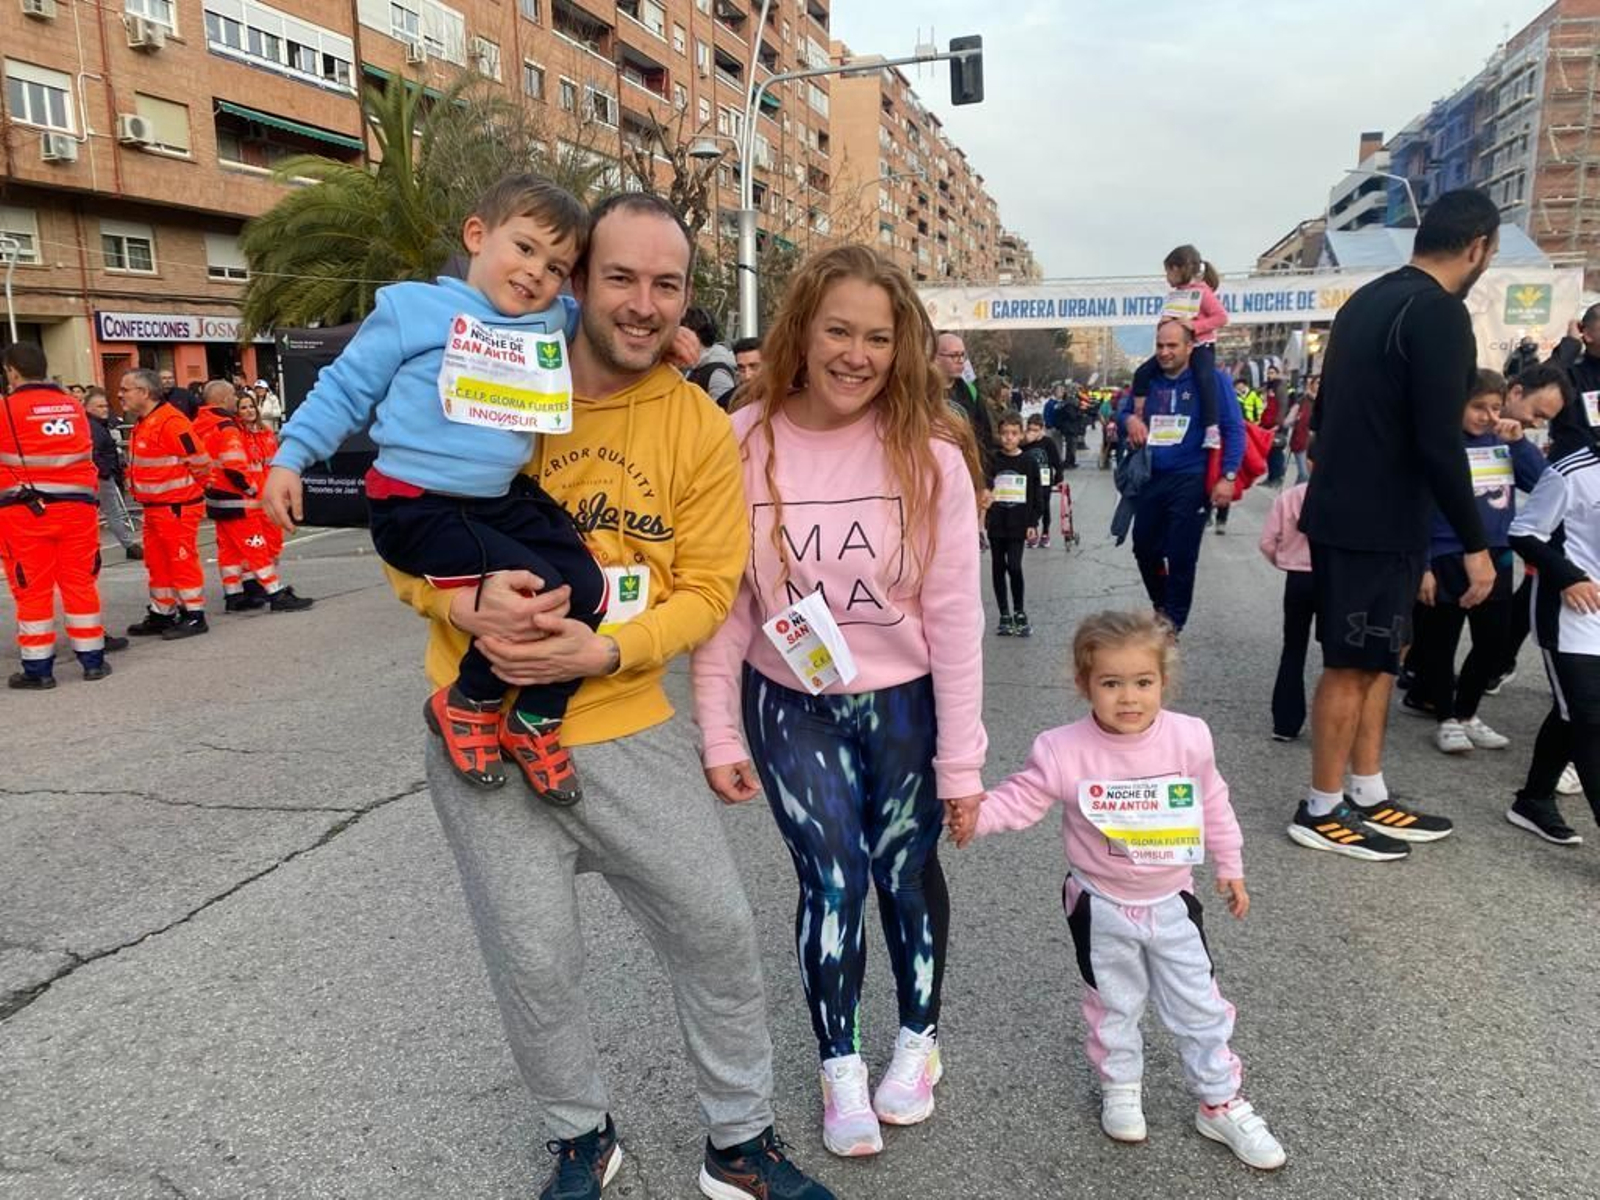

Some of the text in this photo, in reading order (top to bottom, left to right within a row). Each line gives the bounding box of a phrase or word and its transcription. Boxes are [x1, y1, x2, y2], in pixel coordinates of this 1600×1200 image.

[973, 300, 988, 320] 41
[992, 299, 1053, 319] CARRERA
[1058, 298, 1117, 318] URBANA
[1243, 290, 1291, 312] NOCHE
[1295, 290, 1316, 310] DE
[103, 316, 243, 339] CONFECCIONES JOSM
[452, 338, 482, 354] SAN
[484, 347, 525, 365] ANTÓN
[471, 329, 524, 353] NOCHE DE
[489, 394, 525, 409] GLORIA
[529, 400, 569, 412] FUERTES
[41, 418, 75, 436] 061
[469, 406, 538, 428] INNOVASUR
[597, 447, 655, 498] QUALITY
[787, 624, 809, 645] SAN
[1092, 800, 1116, 811] SAN
[1106, 790, 1158, 800] NOCHE DE
[1130, 837, 1164, 847] GLORIA
[1164, 836, 1200, 845] FUERTES
